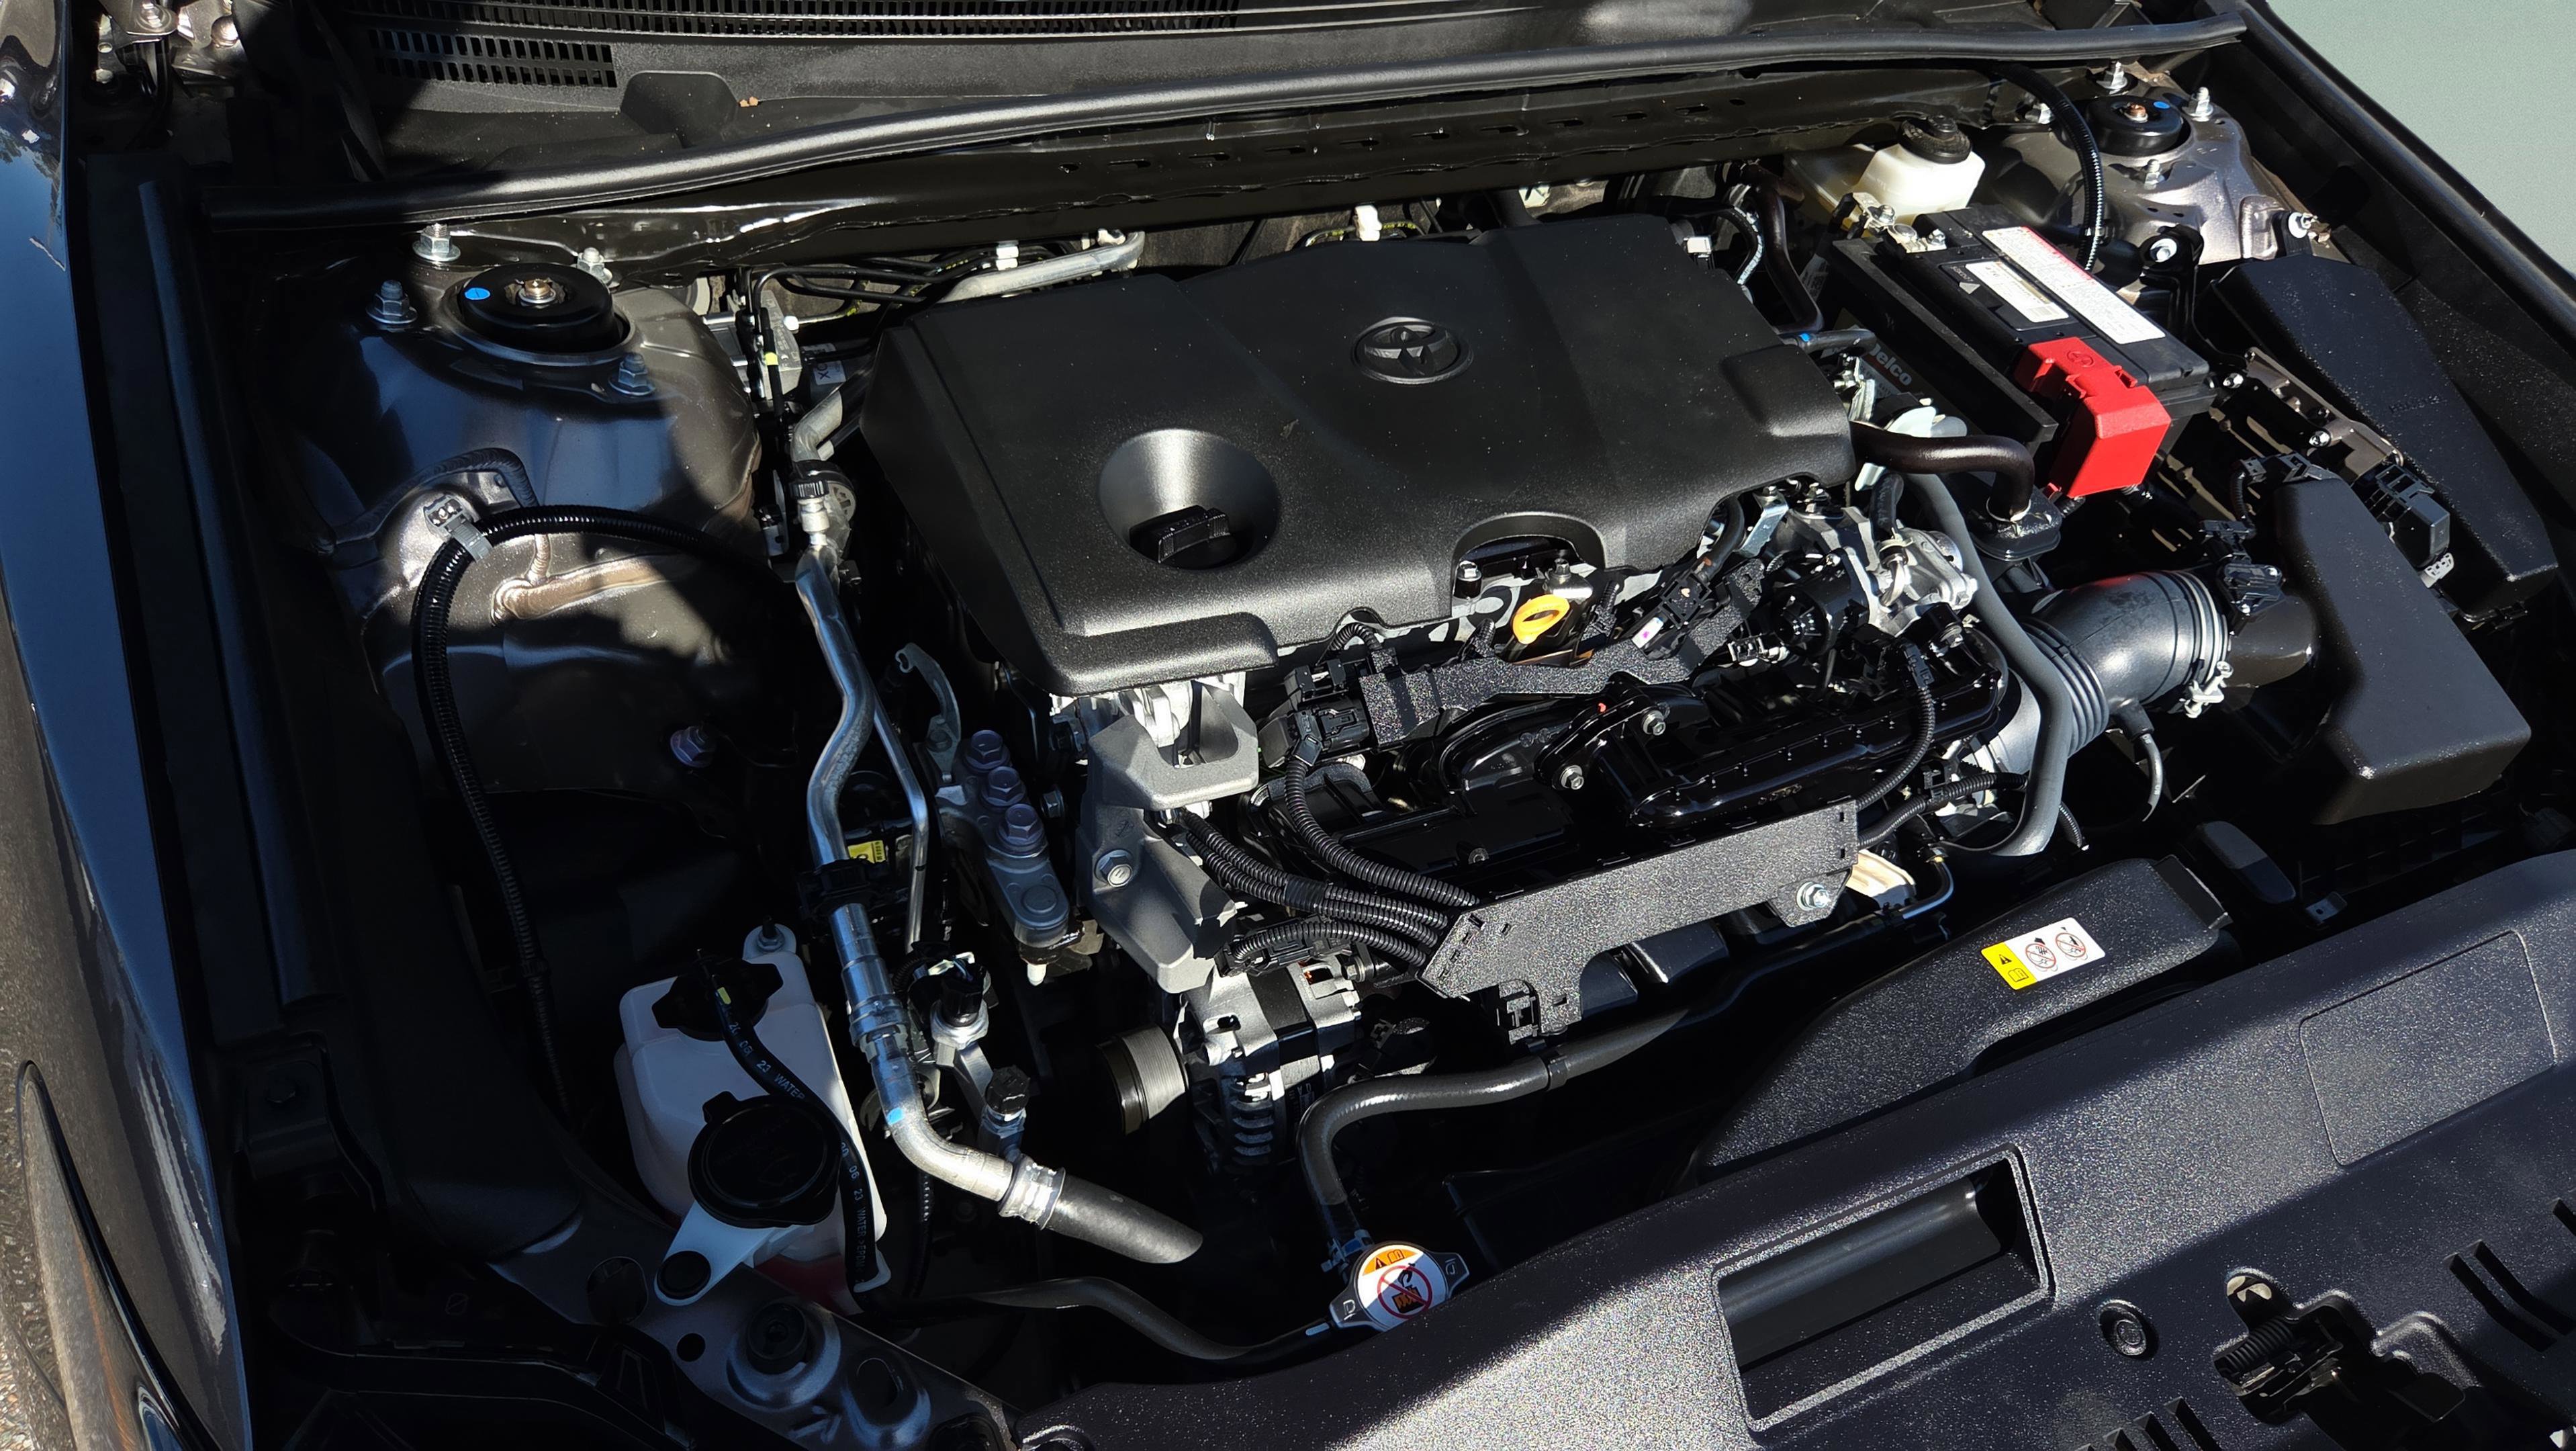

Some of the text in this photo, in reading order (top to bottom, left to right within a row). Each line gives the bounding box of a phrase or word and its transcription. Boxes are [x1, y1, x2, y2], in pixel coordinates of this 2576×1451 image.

[756, 1060, 772, 1073] 23
[774, 1073, 806, 1100] WATER
[849, 1165, 860, 1180] 06
[854, 1188, 864, 1201] 23
